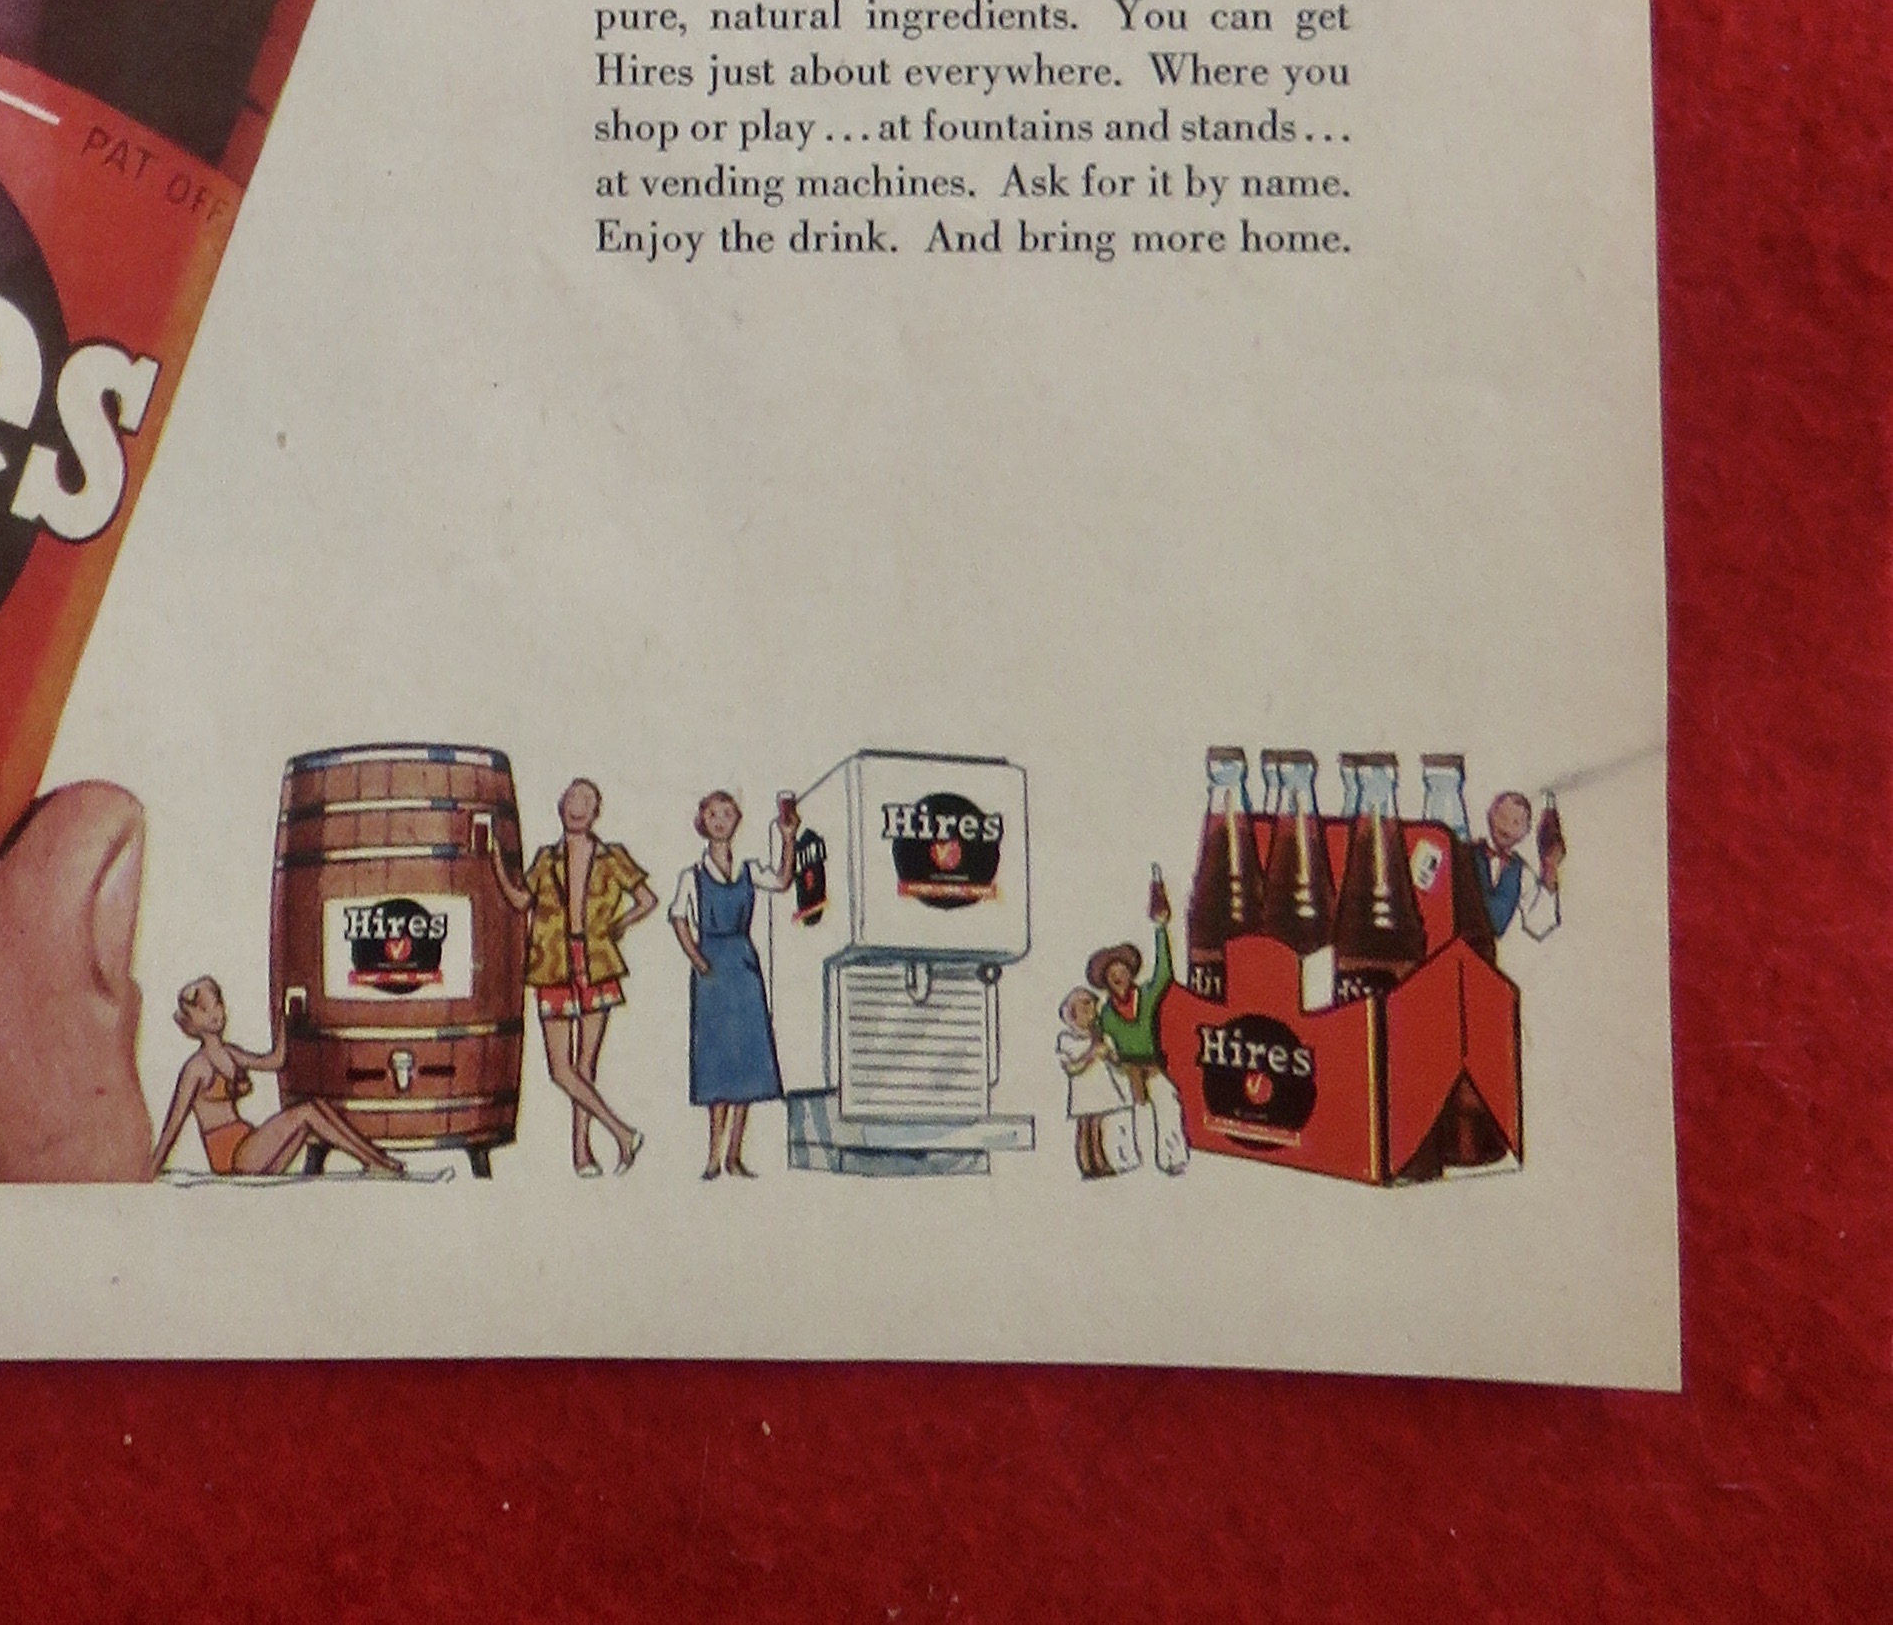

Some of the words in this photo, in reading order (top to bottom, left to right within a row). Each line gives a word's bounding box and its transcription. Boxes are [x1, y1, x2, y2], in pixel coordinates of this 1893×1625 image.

[595, 9, 689, 42] pure,
[1211, 10, 1274, 32] can
[1296, 4, 1352, 42] get
[596, 52, 696, 88] Hires
[707, 54, 776, 98] just
[790, 52, 893, 88] about
[905, 52, 1123, 98] everywhere.
[1149, 52, 1270, 87] Where
[1283, 65, 1351, 97] you
[80, 125, 157, 180] PAT
[595, 108, 681, 154] shop
[691, 121, 729, 143] or
[739, 107, 817, 154] play
[879, 115, 913, 143] at
[924, 108, 1095, 143] fountains
[1105, 108, 1171, 143] and
[1182, 108, 1298, 144] stands
[596, 171, 631, 199] at
[640, 163, 786, 209] vending
[796, 163, 977, 200] machines.
[1000, 163, 1071, 199] Ask
[1082, 163, 1137, 199] for
[1150, 165, 1174, 199] it
[1185, 164, 1231, 209] by
[1242, 176, 1352, 199] name.
[596, 219, 706, 265] Enjoy
[720, 219, 776, 255] the
[789, 219, 899, 255] drink.
[925, 219, 1003, 254] And
[1019, 219, 1117, 264] bring
[1133, 231, 1227, 254] more
[1241, 219, 1352, 255] home.
[881, 803, 1003, 842] Hires
[343, 907, 447, 941] Hires
[1199, 1025, 1313, 1078] Hires
